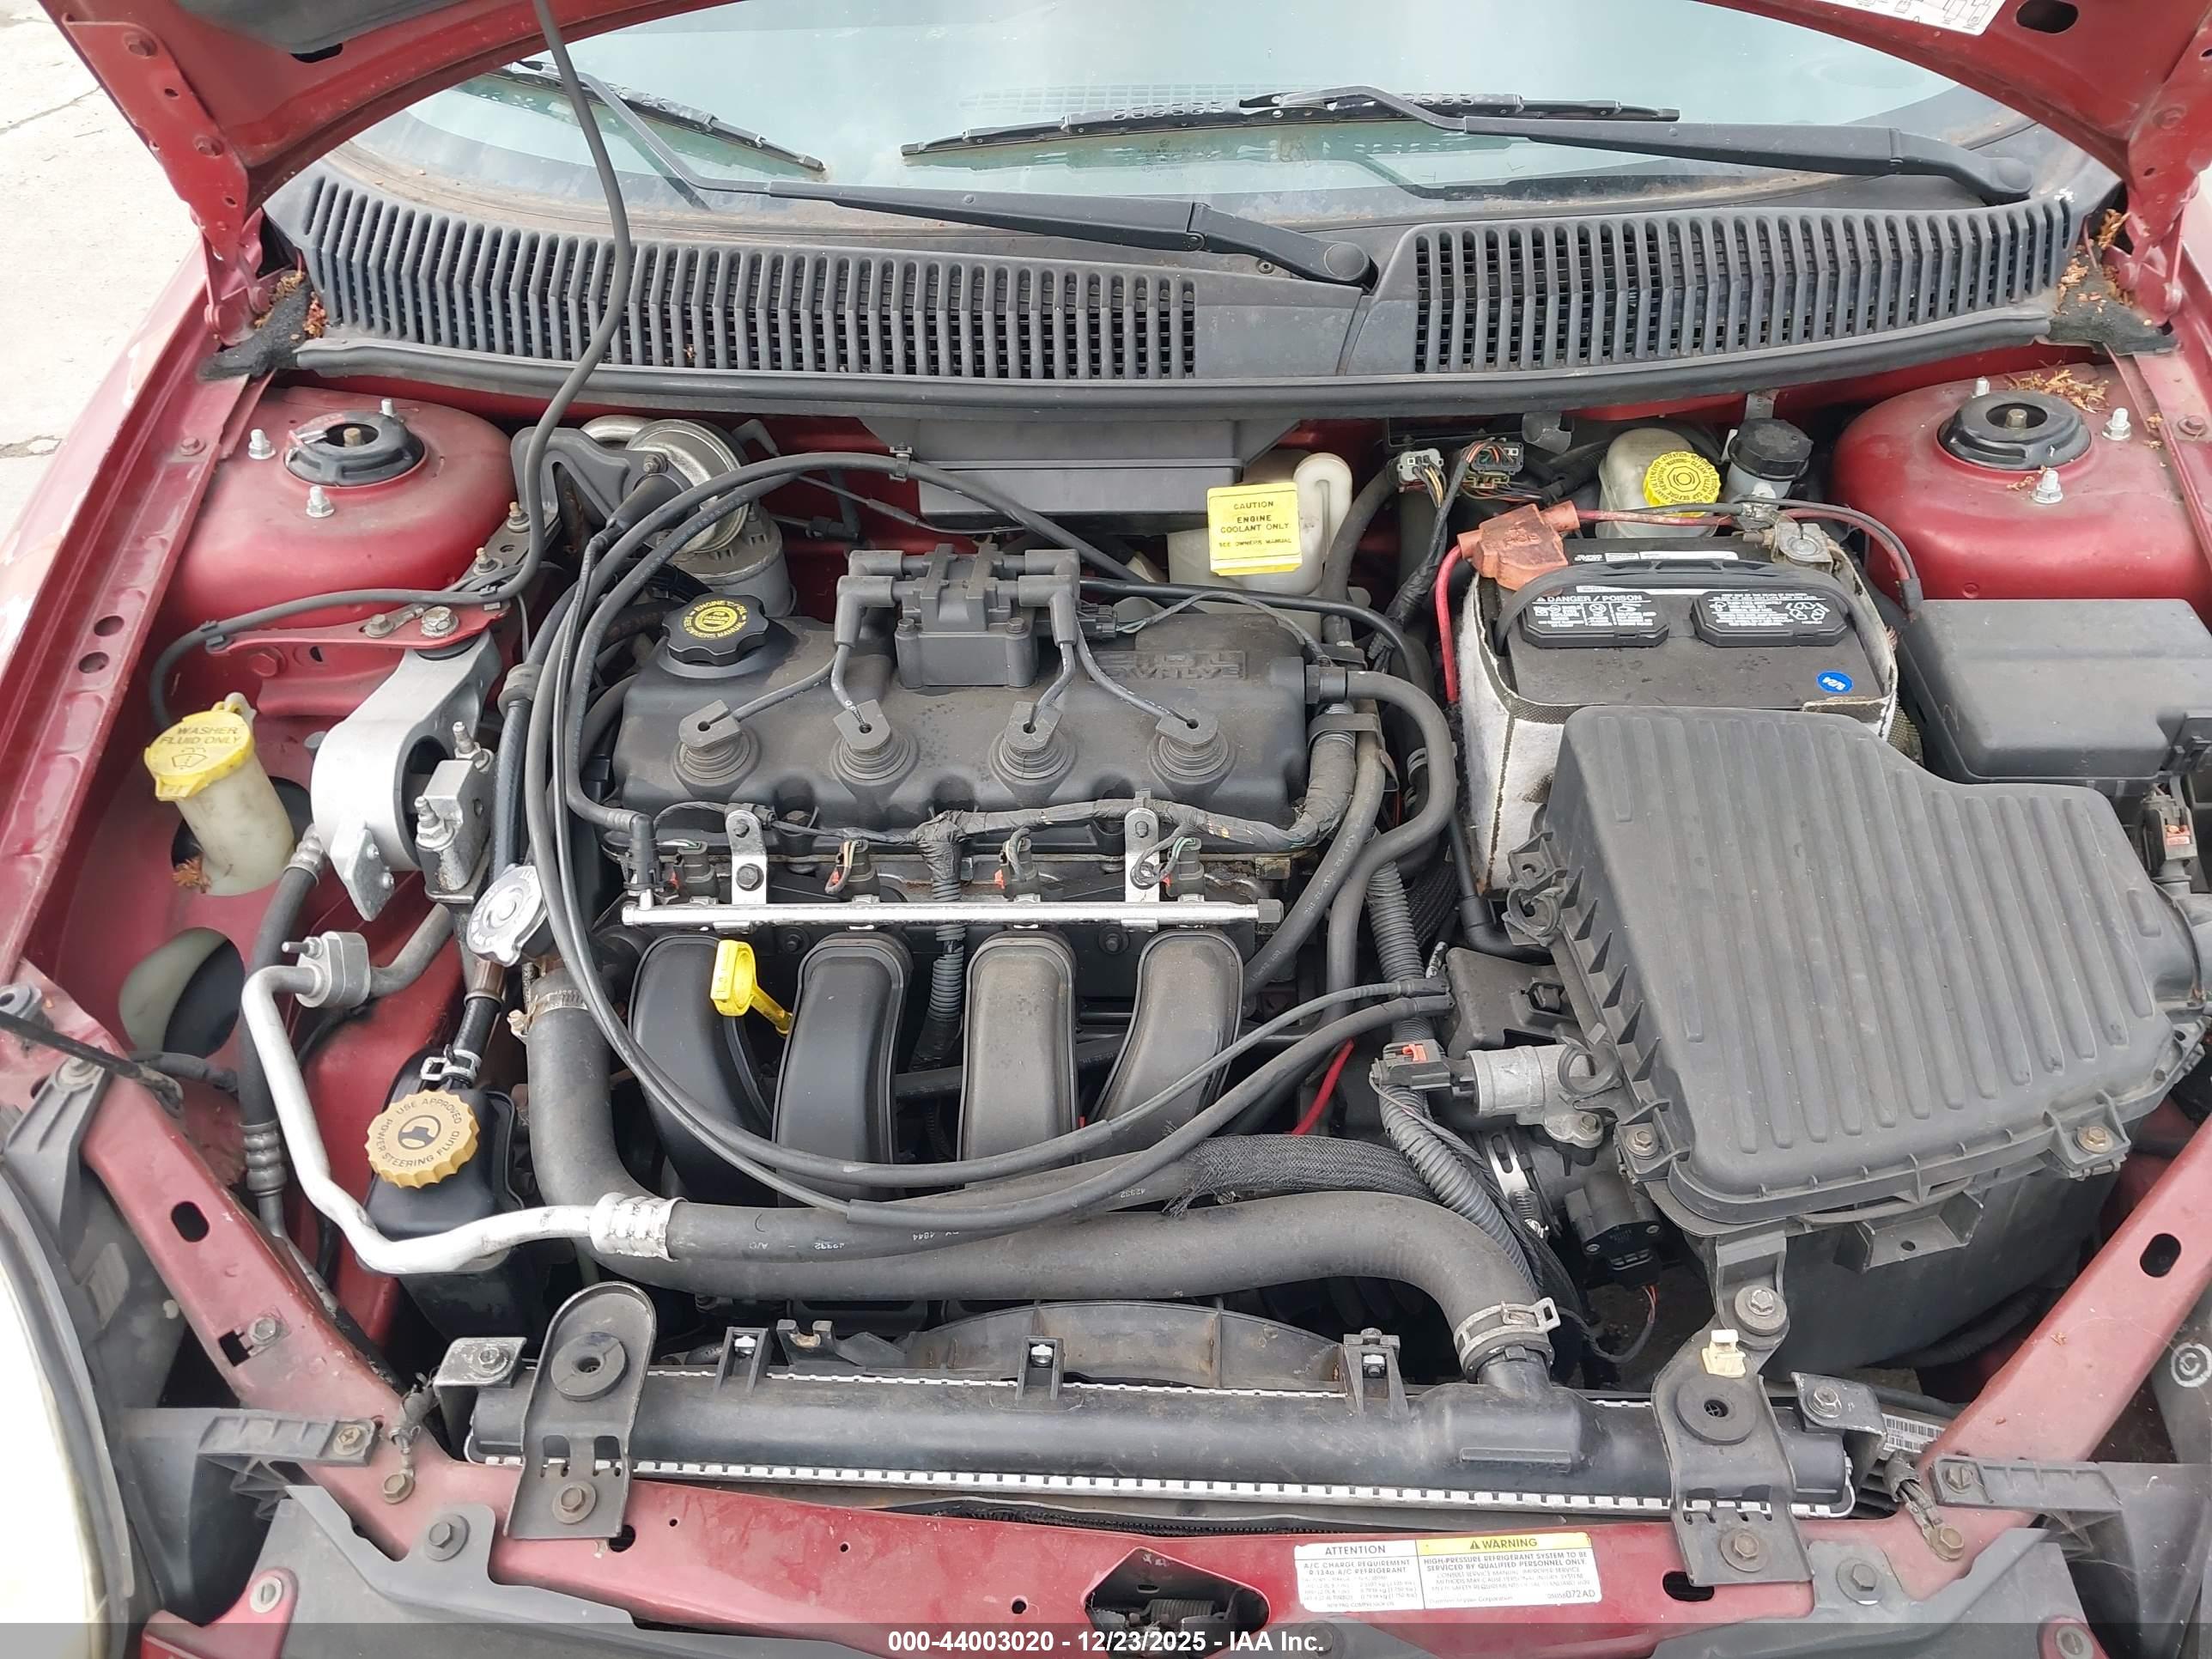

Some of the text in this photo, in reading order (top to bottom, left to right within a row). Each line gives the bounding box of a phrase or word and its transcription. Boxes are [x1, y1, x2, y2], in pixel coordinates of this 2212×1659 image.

[1233, 501, 1273, 510] CAUTION
[1220, 525, 1261, 533] COOLANT
[694, 600, 726, 611] ENGINE
[177, 726, 238, 735] WASHER
[160, 736, 241, 744] FLUID ONLY
[396, 1098, 462, 1125] USE APPROVED
[376, 1118, 460, 1168] POWER STEERING FLUID
[1482, 1538, 1538, 1550] WARNING
[1325, 1545, 1386, 1556] ATTENTION
[1323, 1560, 1354, 1569] CHARGE
[1358, 1559, 1411, 1568] REQUIREMENT
[1424, 1556, 1481, 1565] HIGH-PRESSURE
[1484, 1553, 1534, 1562] REFRIGERANT
[1478, 1561, 1516, 1570] QUALIFIED
[1519, 1559, 1563, 1568] PERSONNEL
